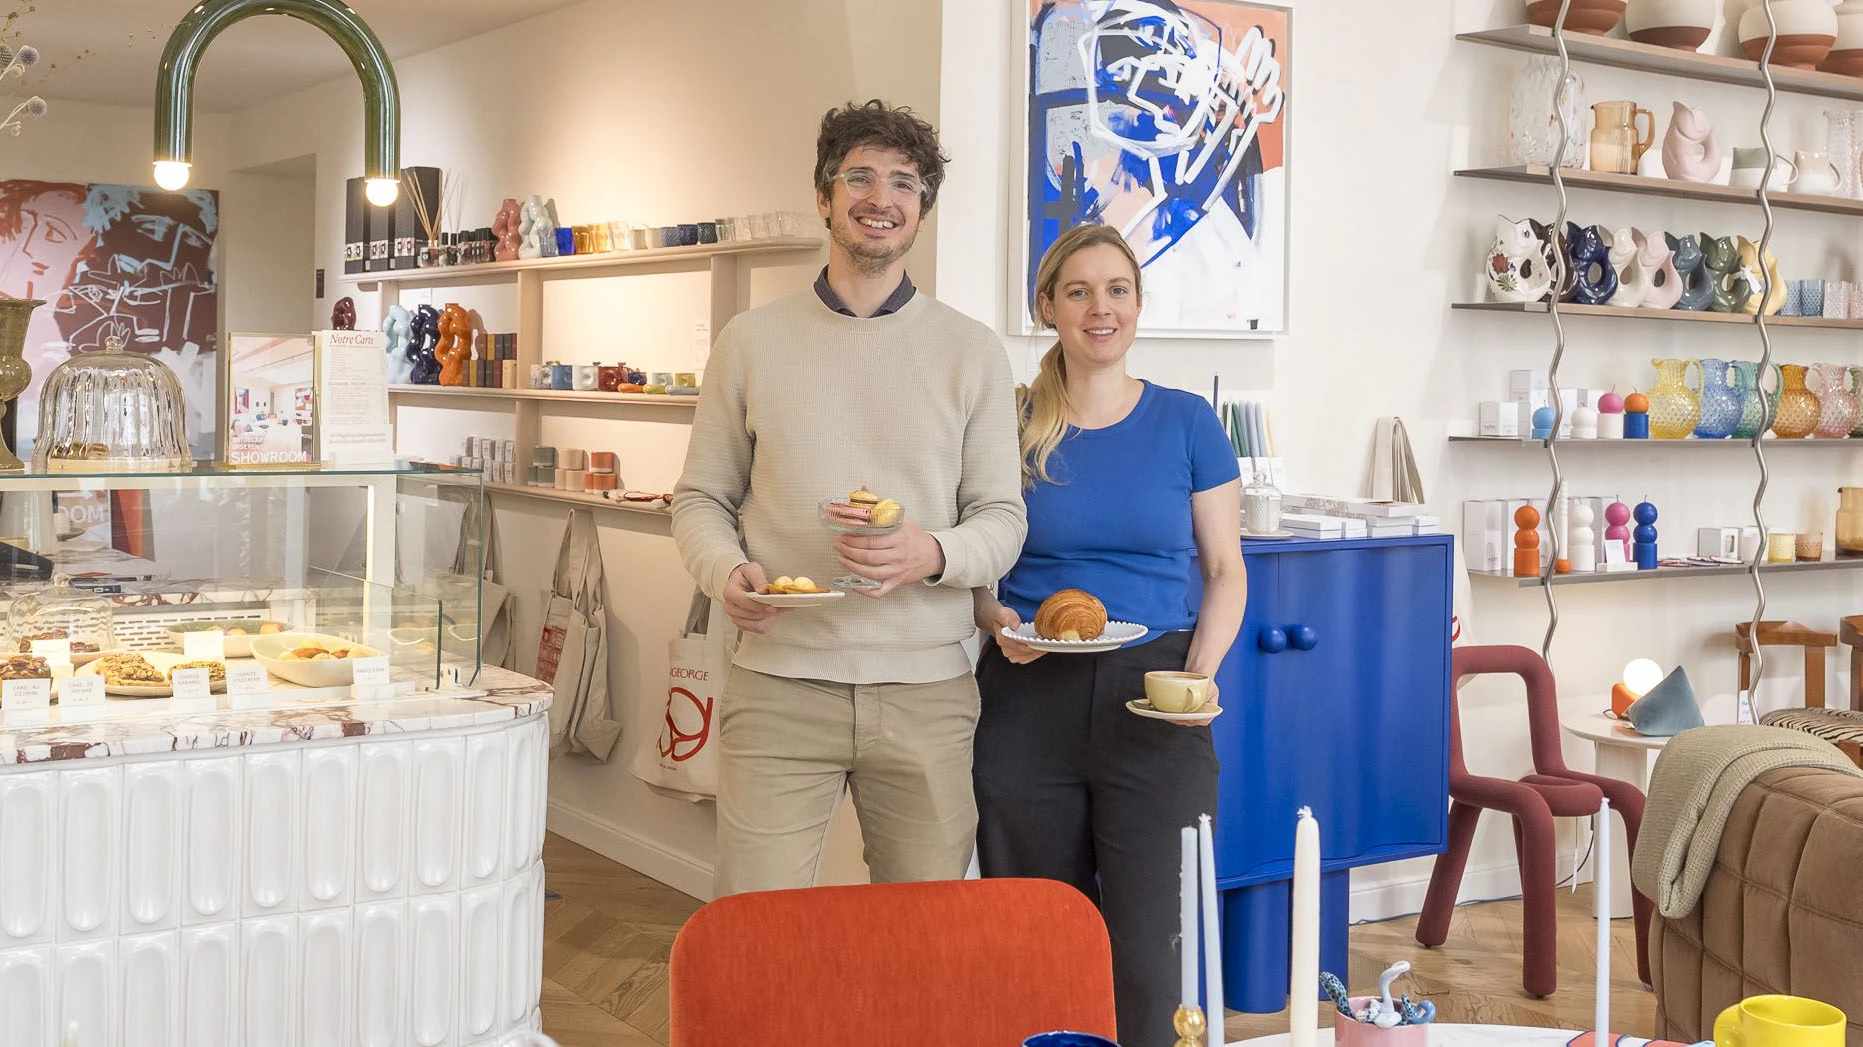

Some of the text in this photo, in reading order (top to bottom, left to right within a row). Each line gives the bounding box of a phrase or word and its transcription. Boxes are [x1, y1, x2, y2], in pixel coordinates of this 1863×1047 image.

[330, 333, 374, 345] Notre Carte
[231, 450, 307, 464] SHOWROOM
